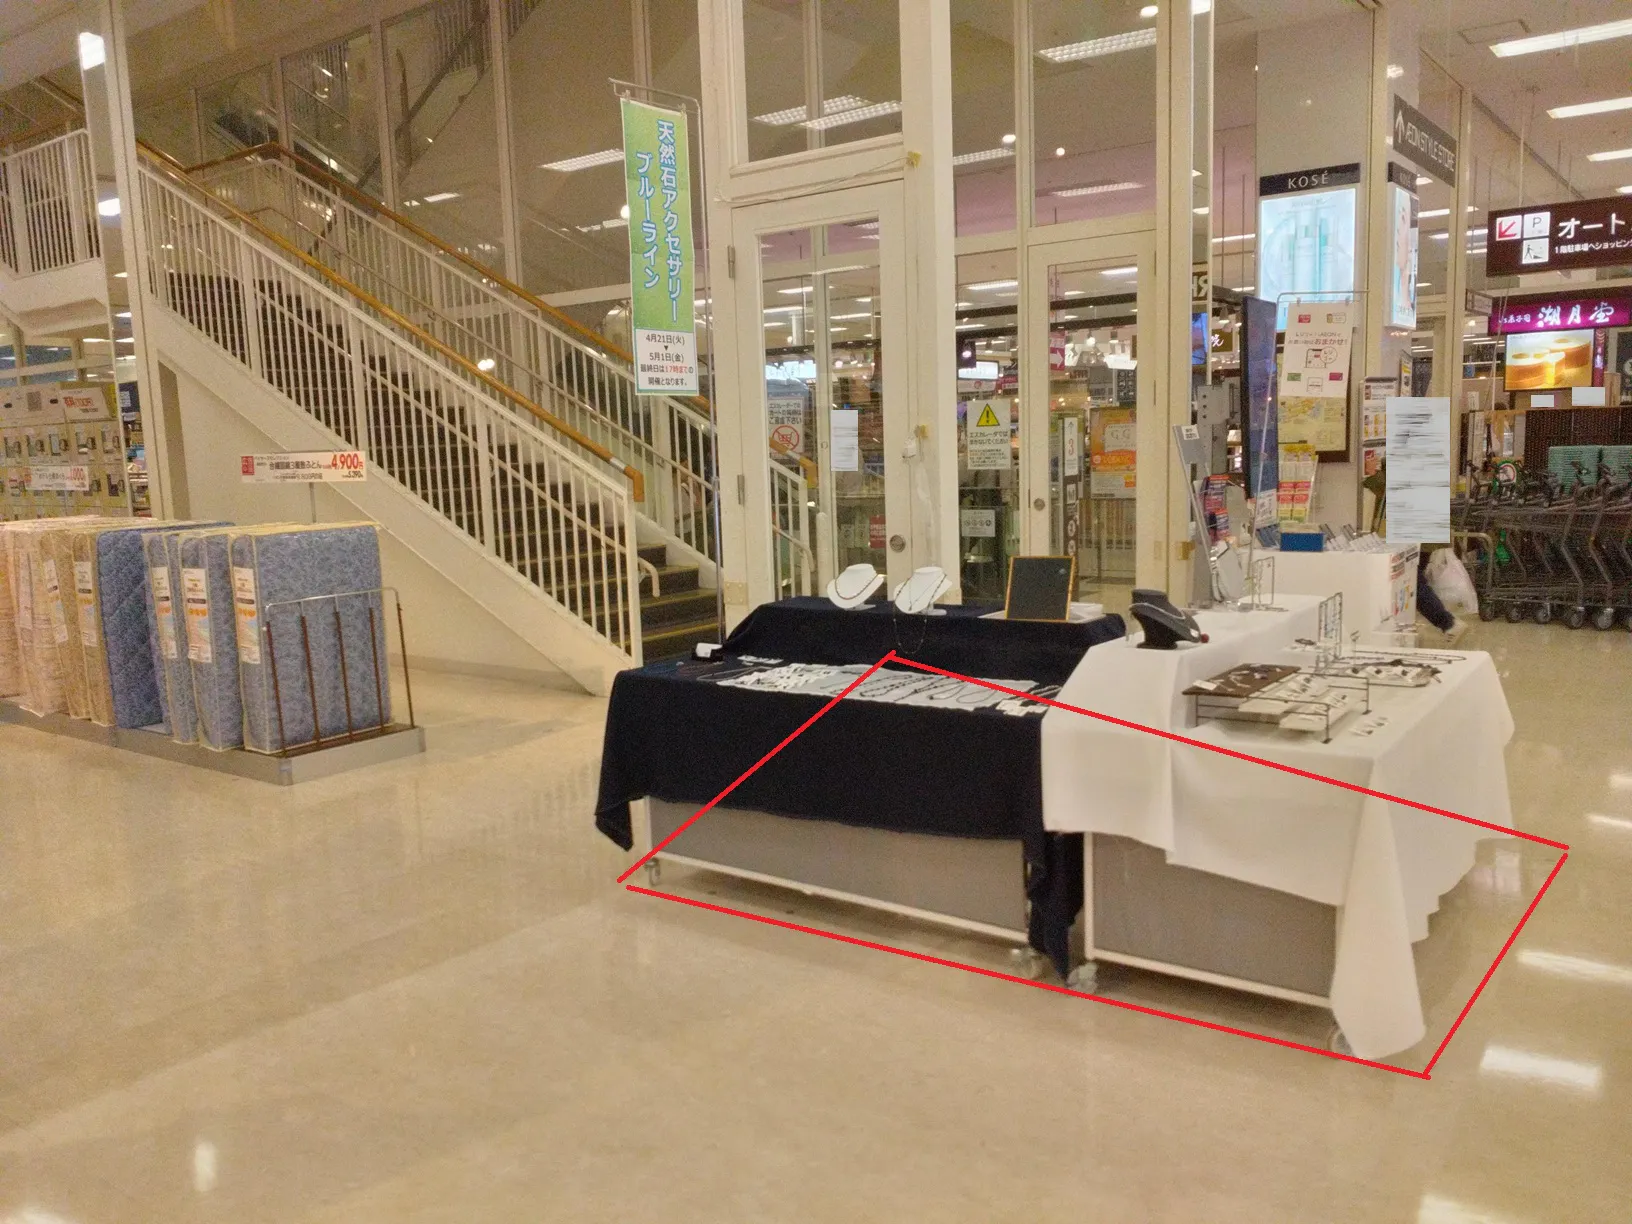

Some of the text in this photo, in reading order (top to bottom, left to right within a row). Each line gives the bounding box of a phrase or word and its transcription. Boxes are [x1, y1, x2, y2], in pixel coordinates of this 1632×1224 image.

[1288, 171, 1328, 189] KOSÉ
[636, 152, 660, 288] ブルーライン
[657, 119, 682, 322] 天然石アクセサリー
[1532, 216, 1542, 229] P
[1558, 212, 1632, 239] オート
[1537, 302, 1614, 328] 湖月堂
[645, 334, 685, 346] 4月21日(火)
[649, 352, 684, 363] 5月1日(金)
[640, 363, 694, 374] 最終日は17時までの
[648, 376, 688, 386] 開催となります。
